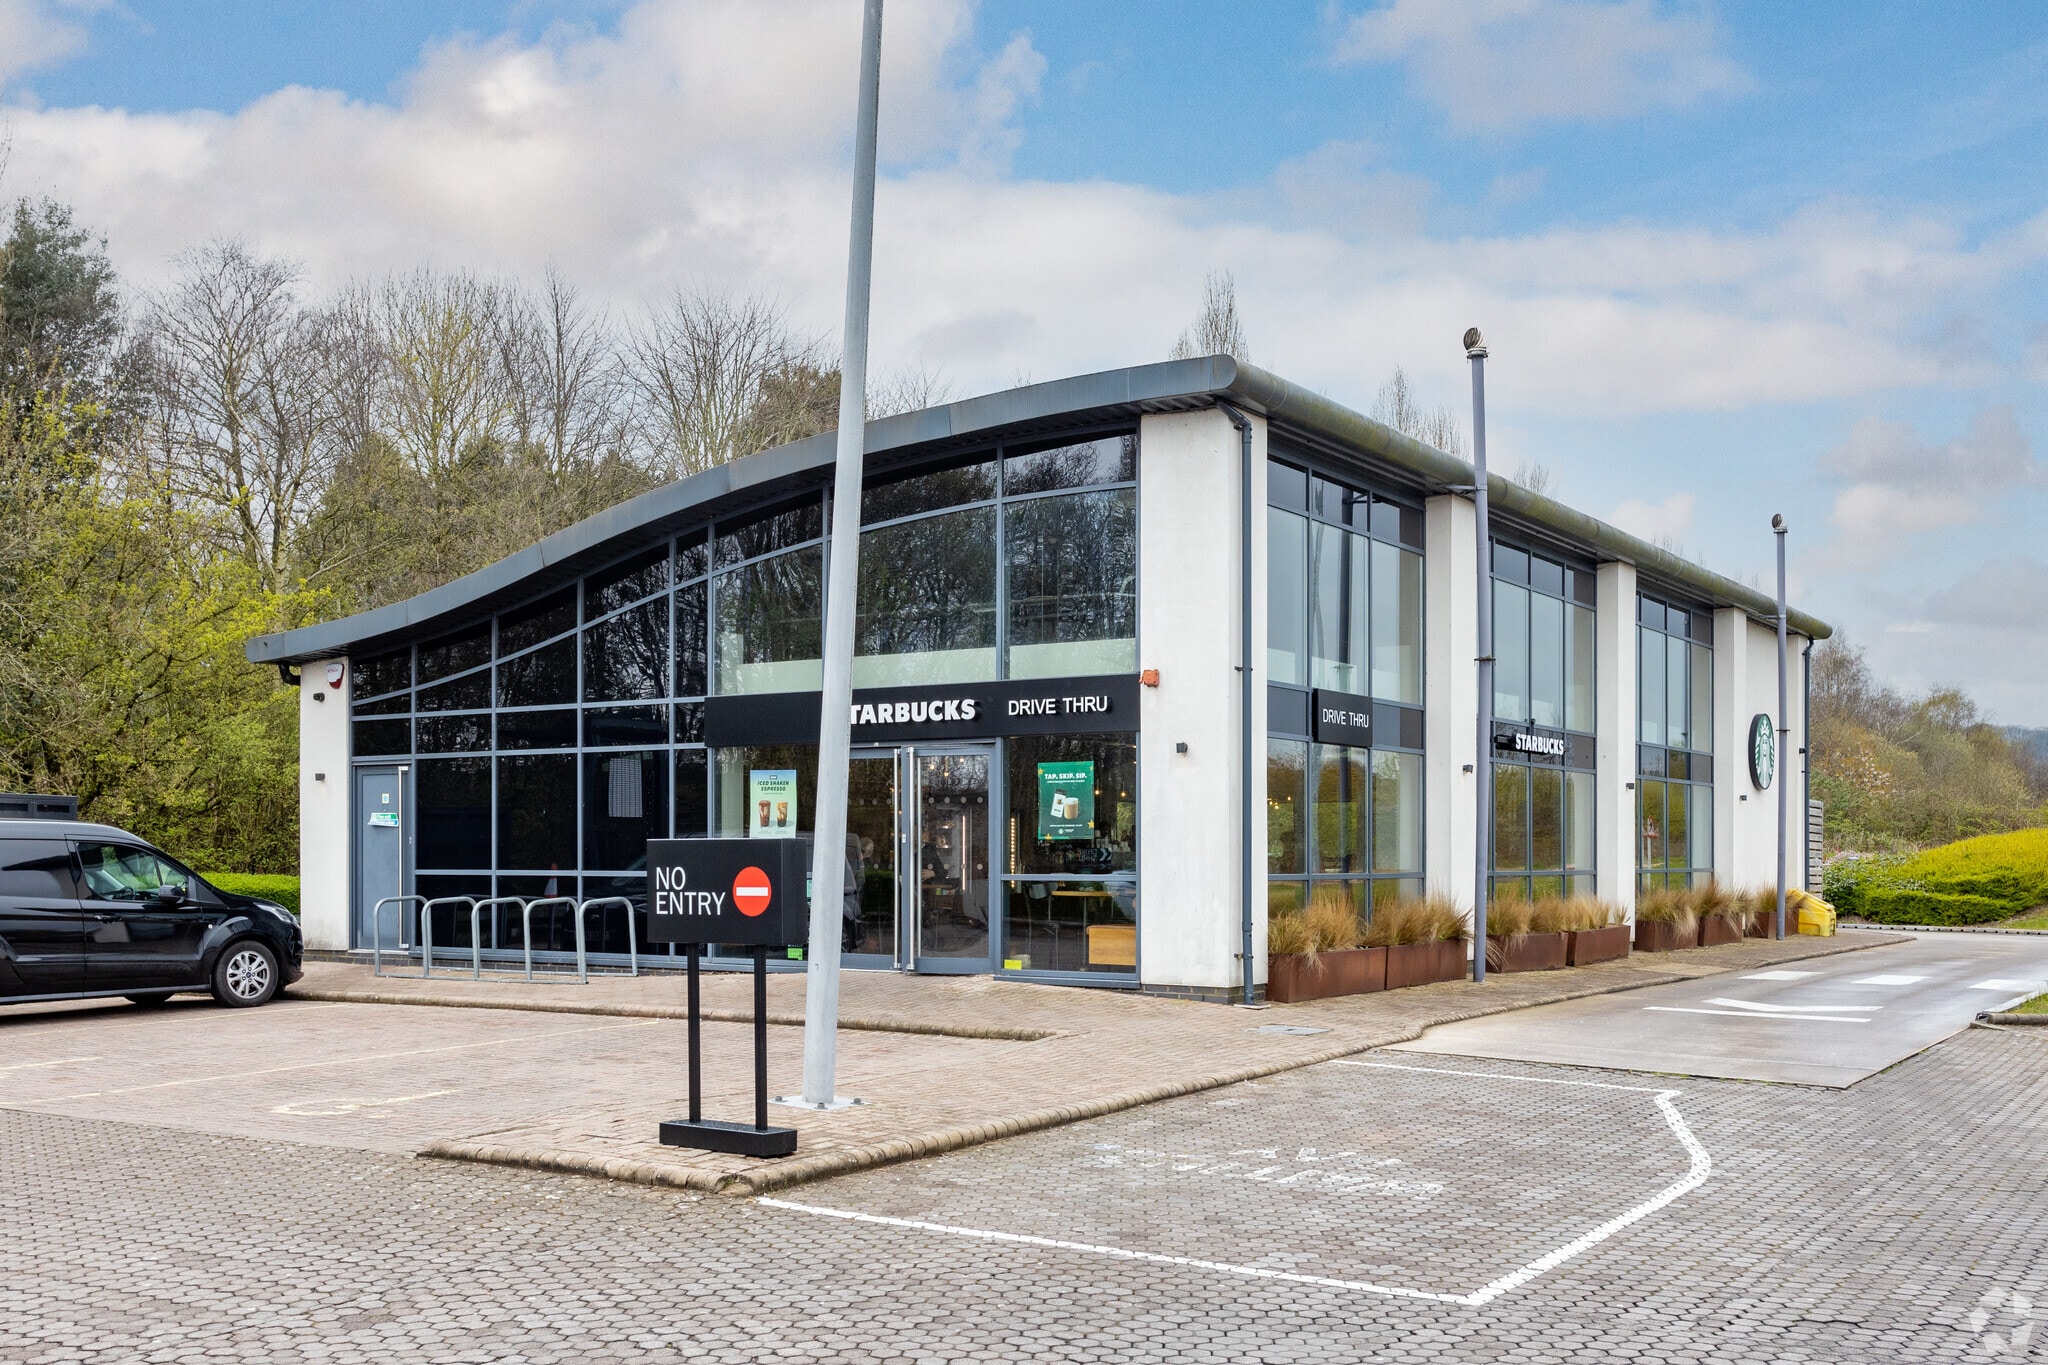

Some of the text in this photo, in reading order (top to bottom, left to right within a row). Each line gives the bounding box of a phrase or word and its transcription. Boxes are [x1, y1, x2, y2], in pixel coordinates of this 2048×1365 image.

[850, 695, 1108, 724] TARBUCKS DRIVE THRU
[1322, 708, 1369, 728] DRIVE THRU
[1515, 733, 1564, 756] STARBUCKS
[1059, 772, 1075, 780] SKIP.
[656, 866, 686, 891] NO
[656, 891, 726, 915] ENTRY
